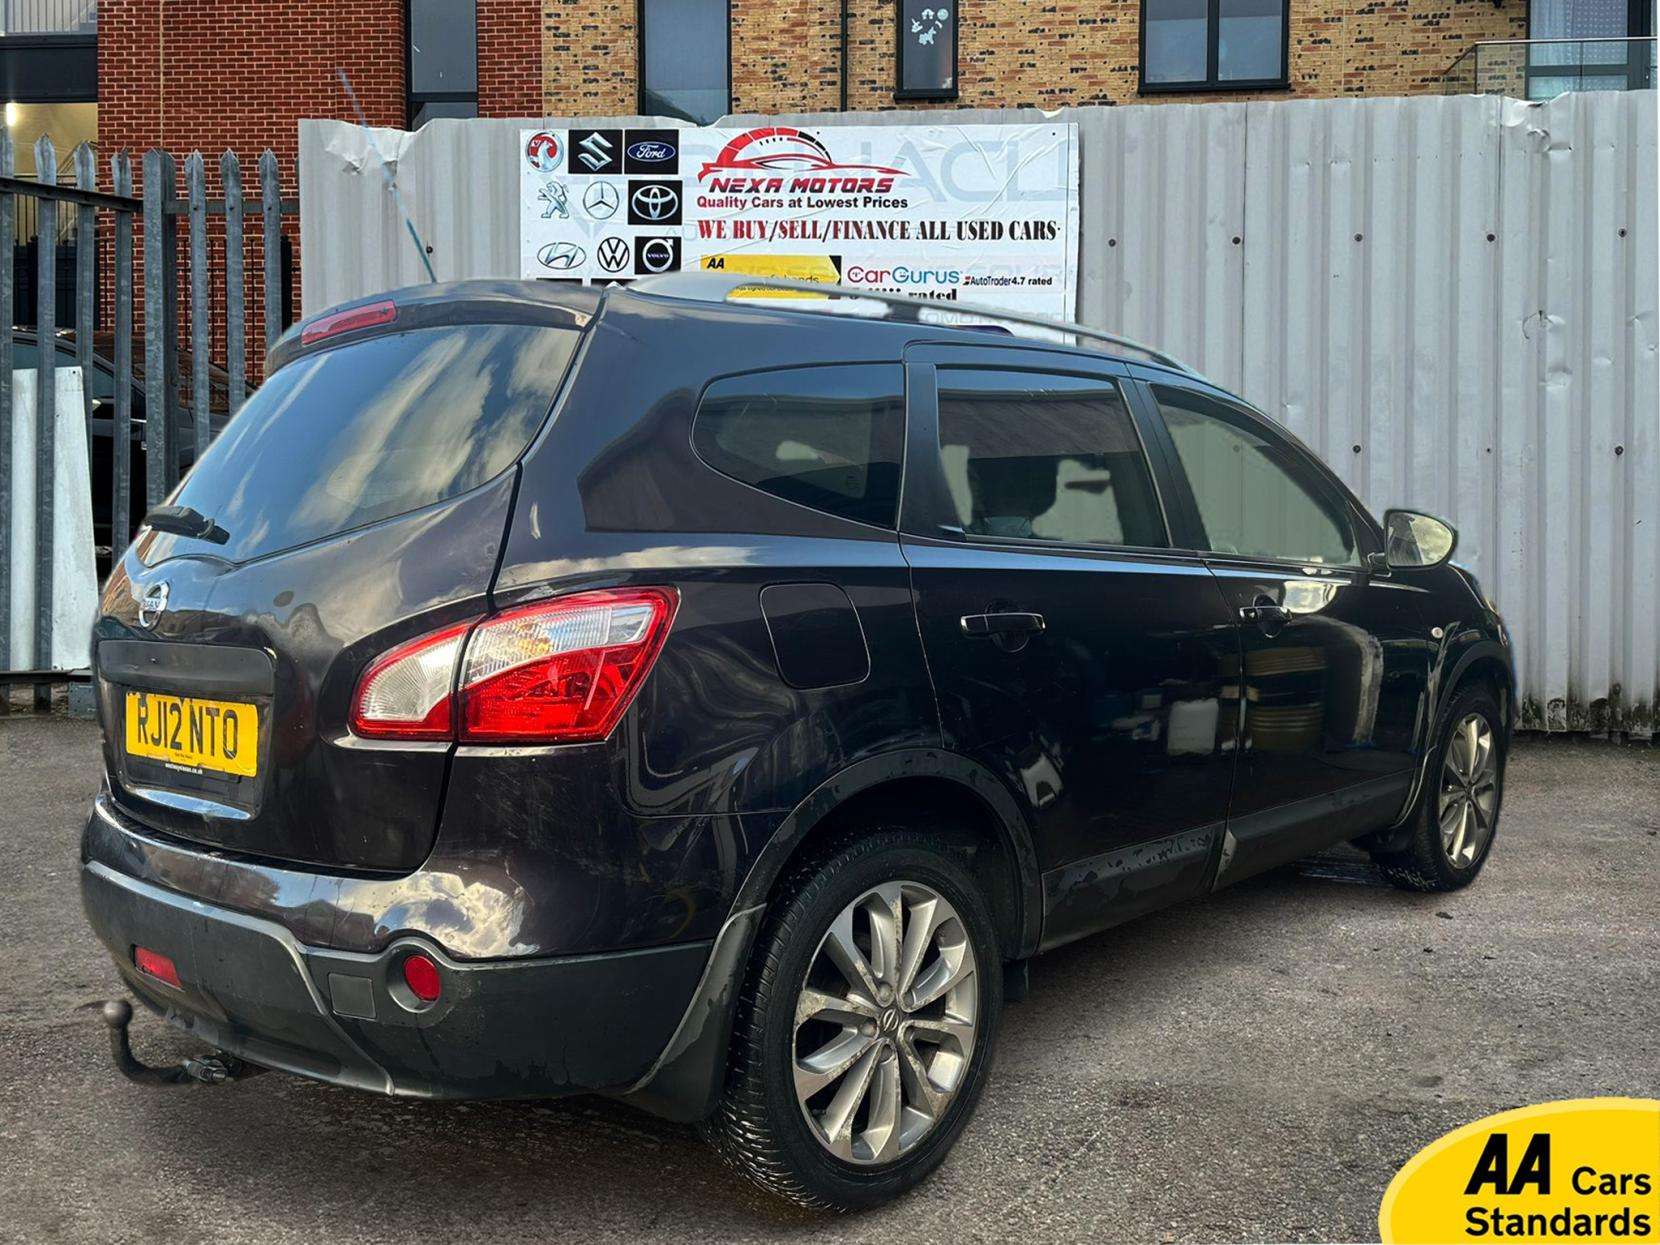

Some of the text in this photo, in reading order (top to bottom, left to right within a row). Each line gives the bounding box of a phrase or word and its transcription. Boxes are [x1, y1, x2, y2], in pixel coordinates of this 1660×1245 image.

[636, 144, 666, 159] Ford
[709, 177, 894, 193] NEXA MOTORS
[697, 196, 908, 210] Quality Cars at Lowest Prices
[697, 219, 727, 240] WE
[916, 220, 951, 240] ALL
[956, 220, 1004, 241] USED
[1008, 220, 1057, 241] CARS
[706, 258, 725, 269] AA
[847, 266, 960, 284] CarGurus
[1028, 277, 1053, 286] rated
